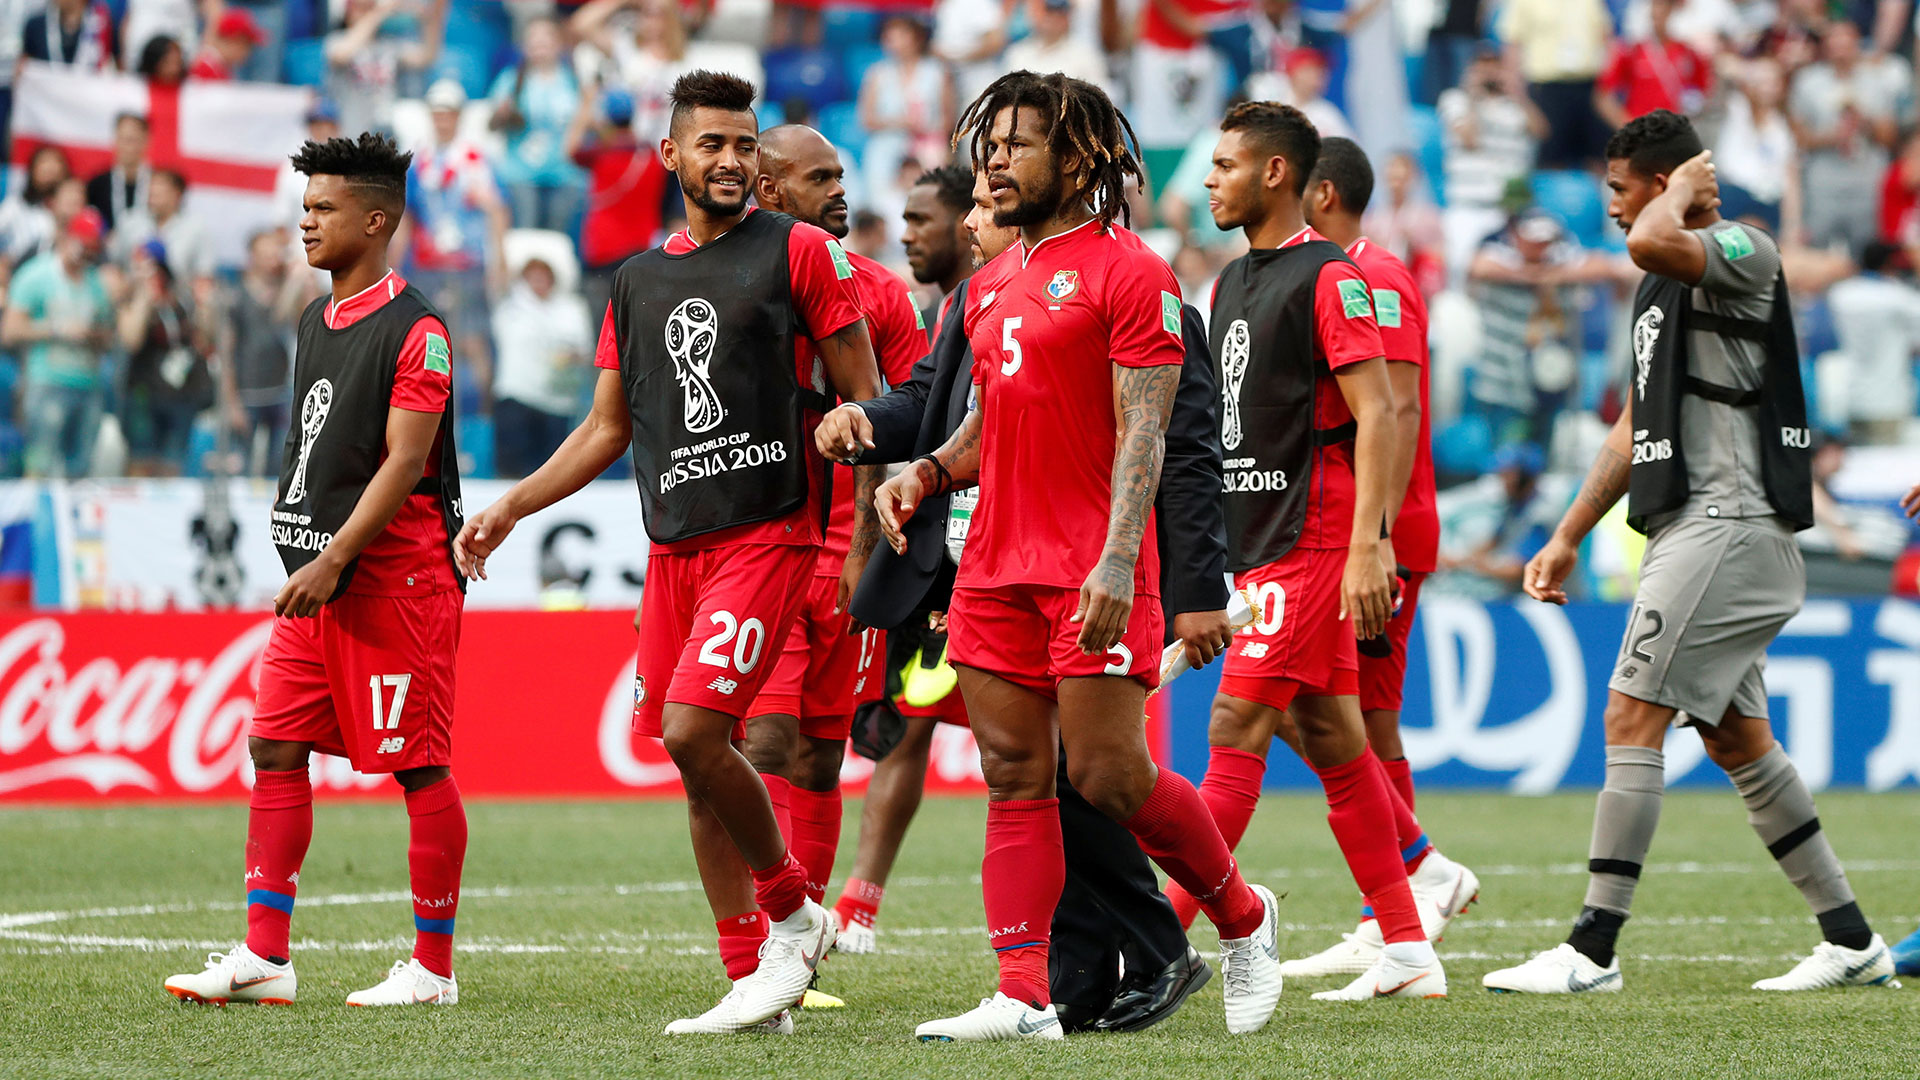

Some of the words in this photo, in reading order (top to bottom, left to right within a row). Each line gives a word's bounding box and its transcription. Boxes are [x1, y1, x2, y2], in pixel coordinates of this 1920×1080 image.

[1001, 316, 1023, 377] 5
[659, 452, 729, 494] RUSSIA
[729, 440, 787, 470] 2018
[670, 447, 692, 461] FIFA
[691, 436, 728, 454] WORLD
[728, 431, 751, 445] CUP
[1632, 438, 1673, 465] 2018
[1237, 470, 1288, 492] 2018
[278, 511, 298, 524] WORLD
[298, 514, 312, 525] CUP
[292, 527, 333, 553] 2018
[698, 609, 765, 674] 20
[1624, 604, 1667, 666] 12
[369, 673, 412, 730] 17
